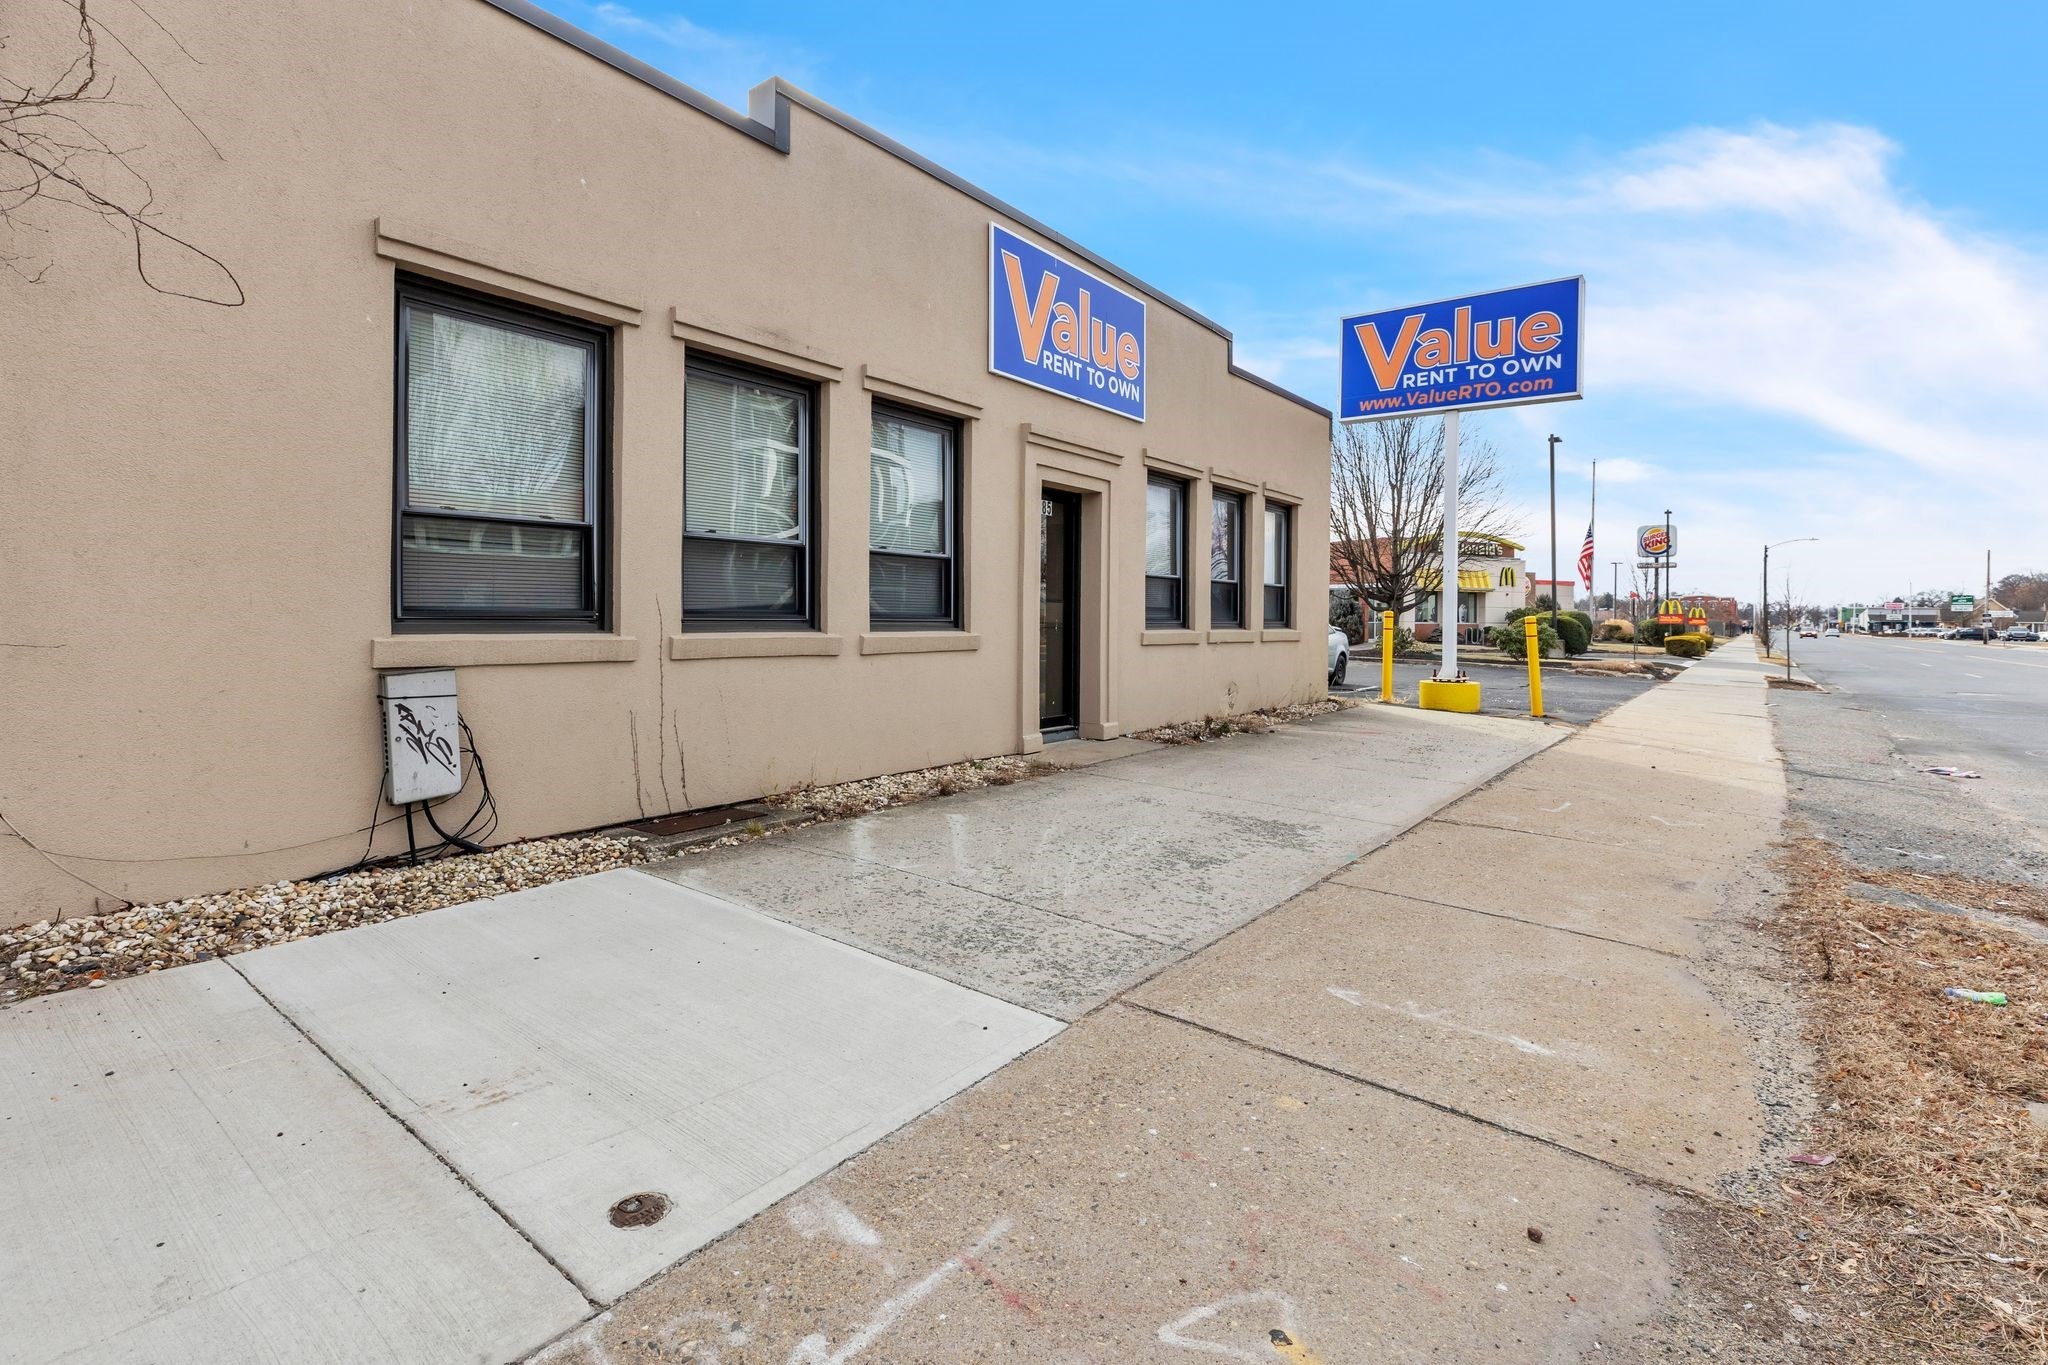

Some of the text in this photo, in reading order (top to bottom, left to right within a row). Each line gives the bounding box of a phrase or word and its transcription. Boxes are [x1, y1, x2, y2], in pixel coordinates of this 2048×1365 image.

[1001, 248, 1141, 380] Value
[1353, 305, 1563, 391] Value
[1043, 350, 1140, 402] RENT TO OWN
[1402, 354, 1562, 388] RENT TO OWN
[1359, 376, 1553, 411] www.ValueRTO.com
[1042, 501, 1052, 515] 85
[1438, 541, 1503, 556] Donald's
[1644, 537, 1670, 549] KING
